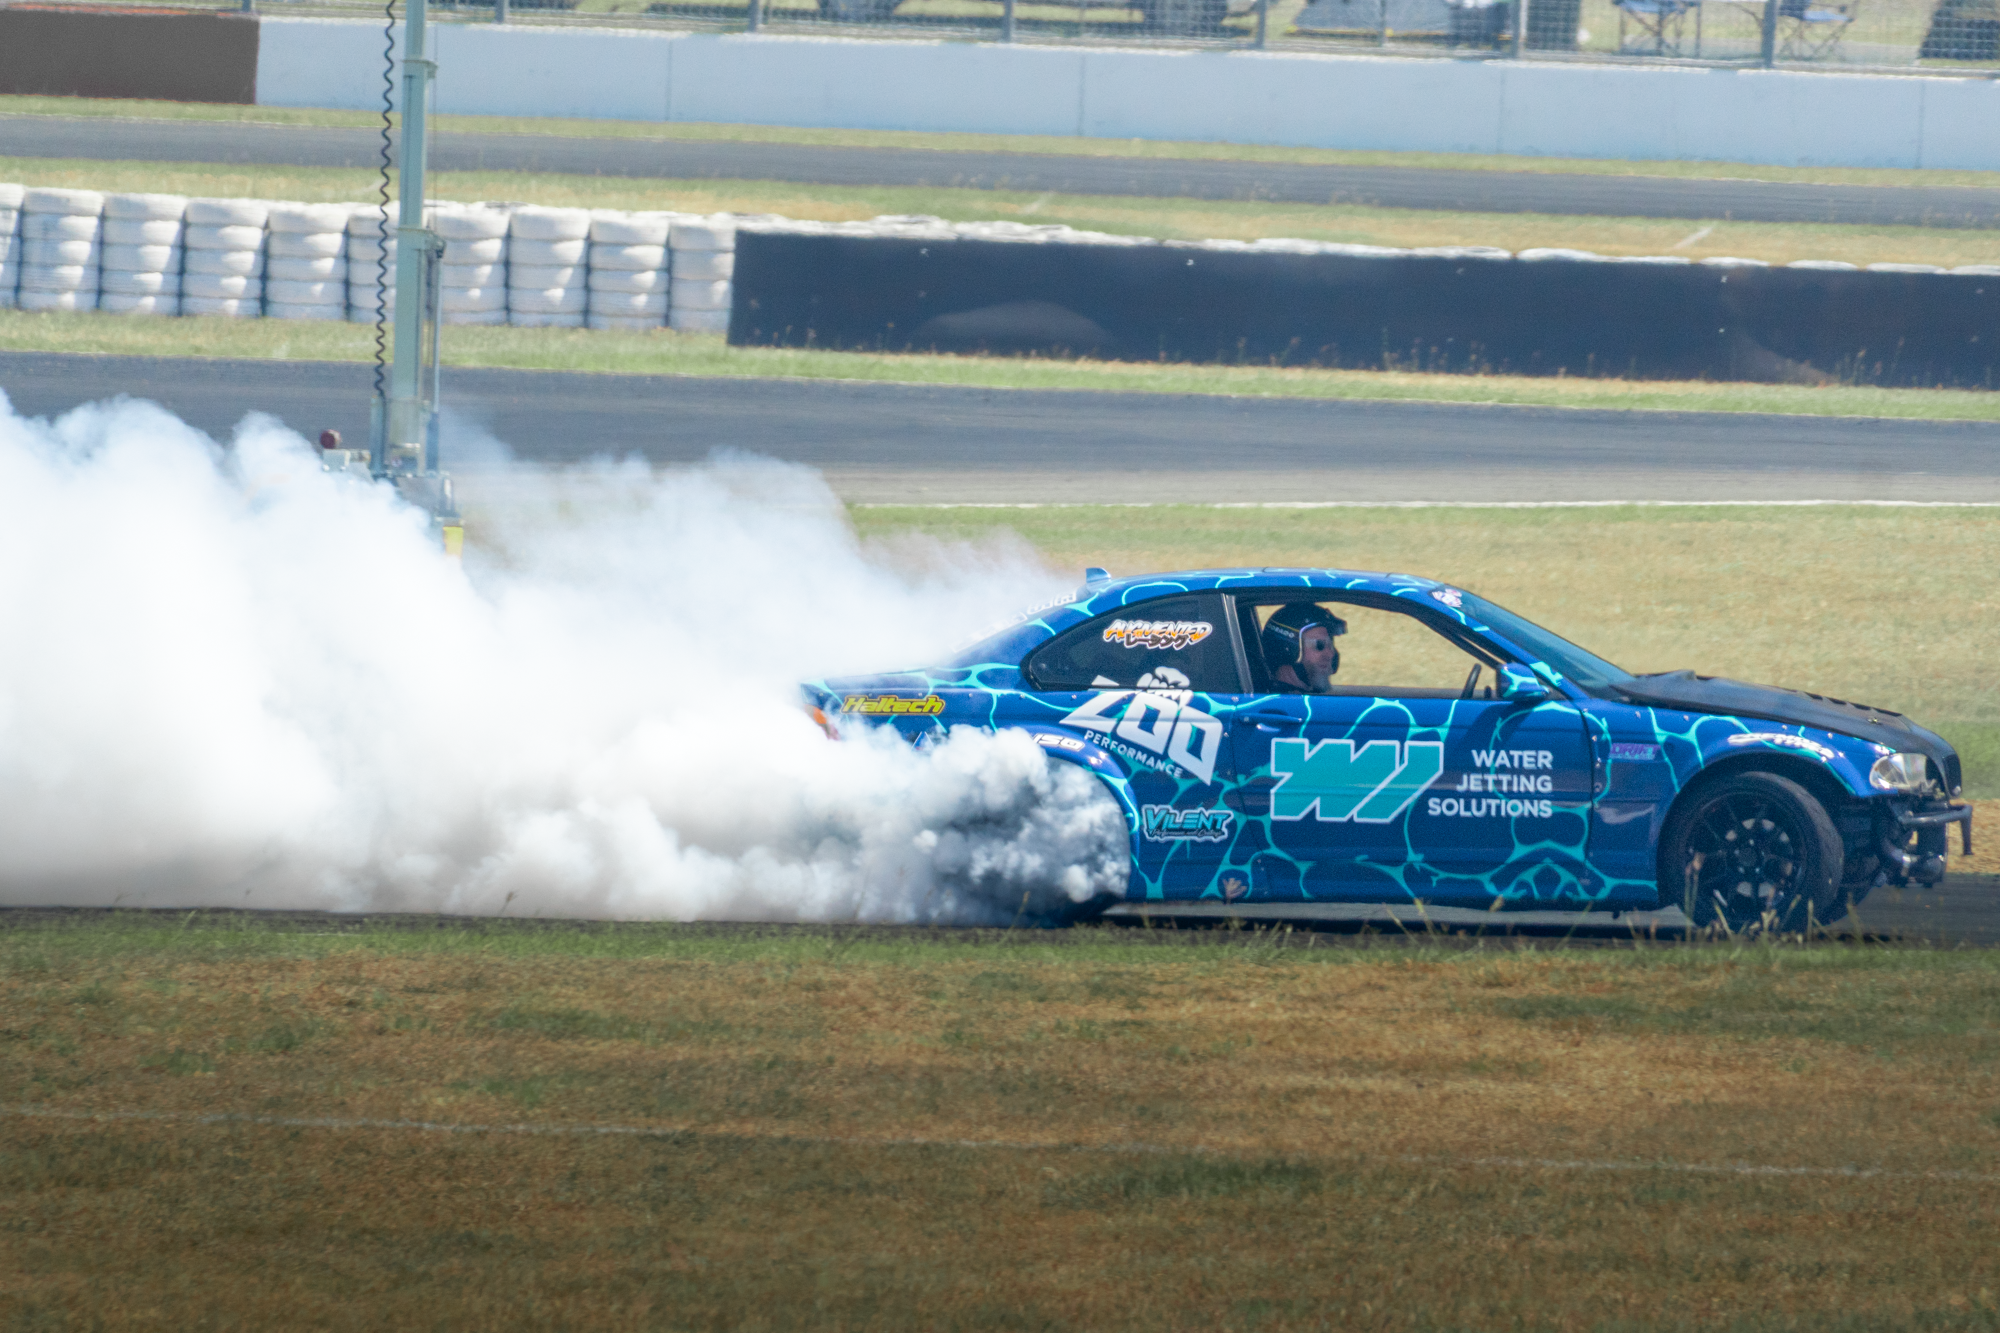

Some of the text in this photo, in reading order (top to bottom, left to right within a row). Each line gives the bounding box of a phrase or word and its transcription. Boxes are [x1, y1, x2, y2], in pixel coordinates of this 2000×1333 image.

[1104, 620, 1212, 643] AUGMENTED
[842, 697, 943, 713] Haltech
[1085, 730, 1183, 778] PERFORMANCE
[1471, 749, 1553, 769] WATER
[1456, 773, 1553, 793] JETTING
[1428, 797, 1553, 818] SOLUTIONS
[1146, 808, 1229, 832] VILENT
